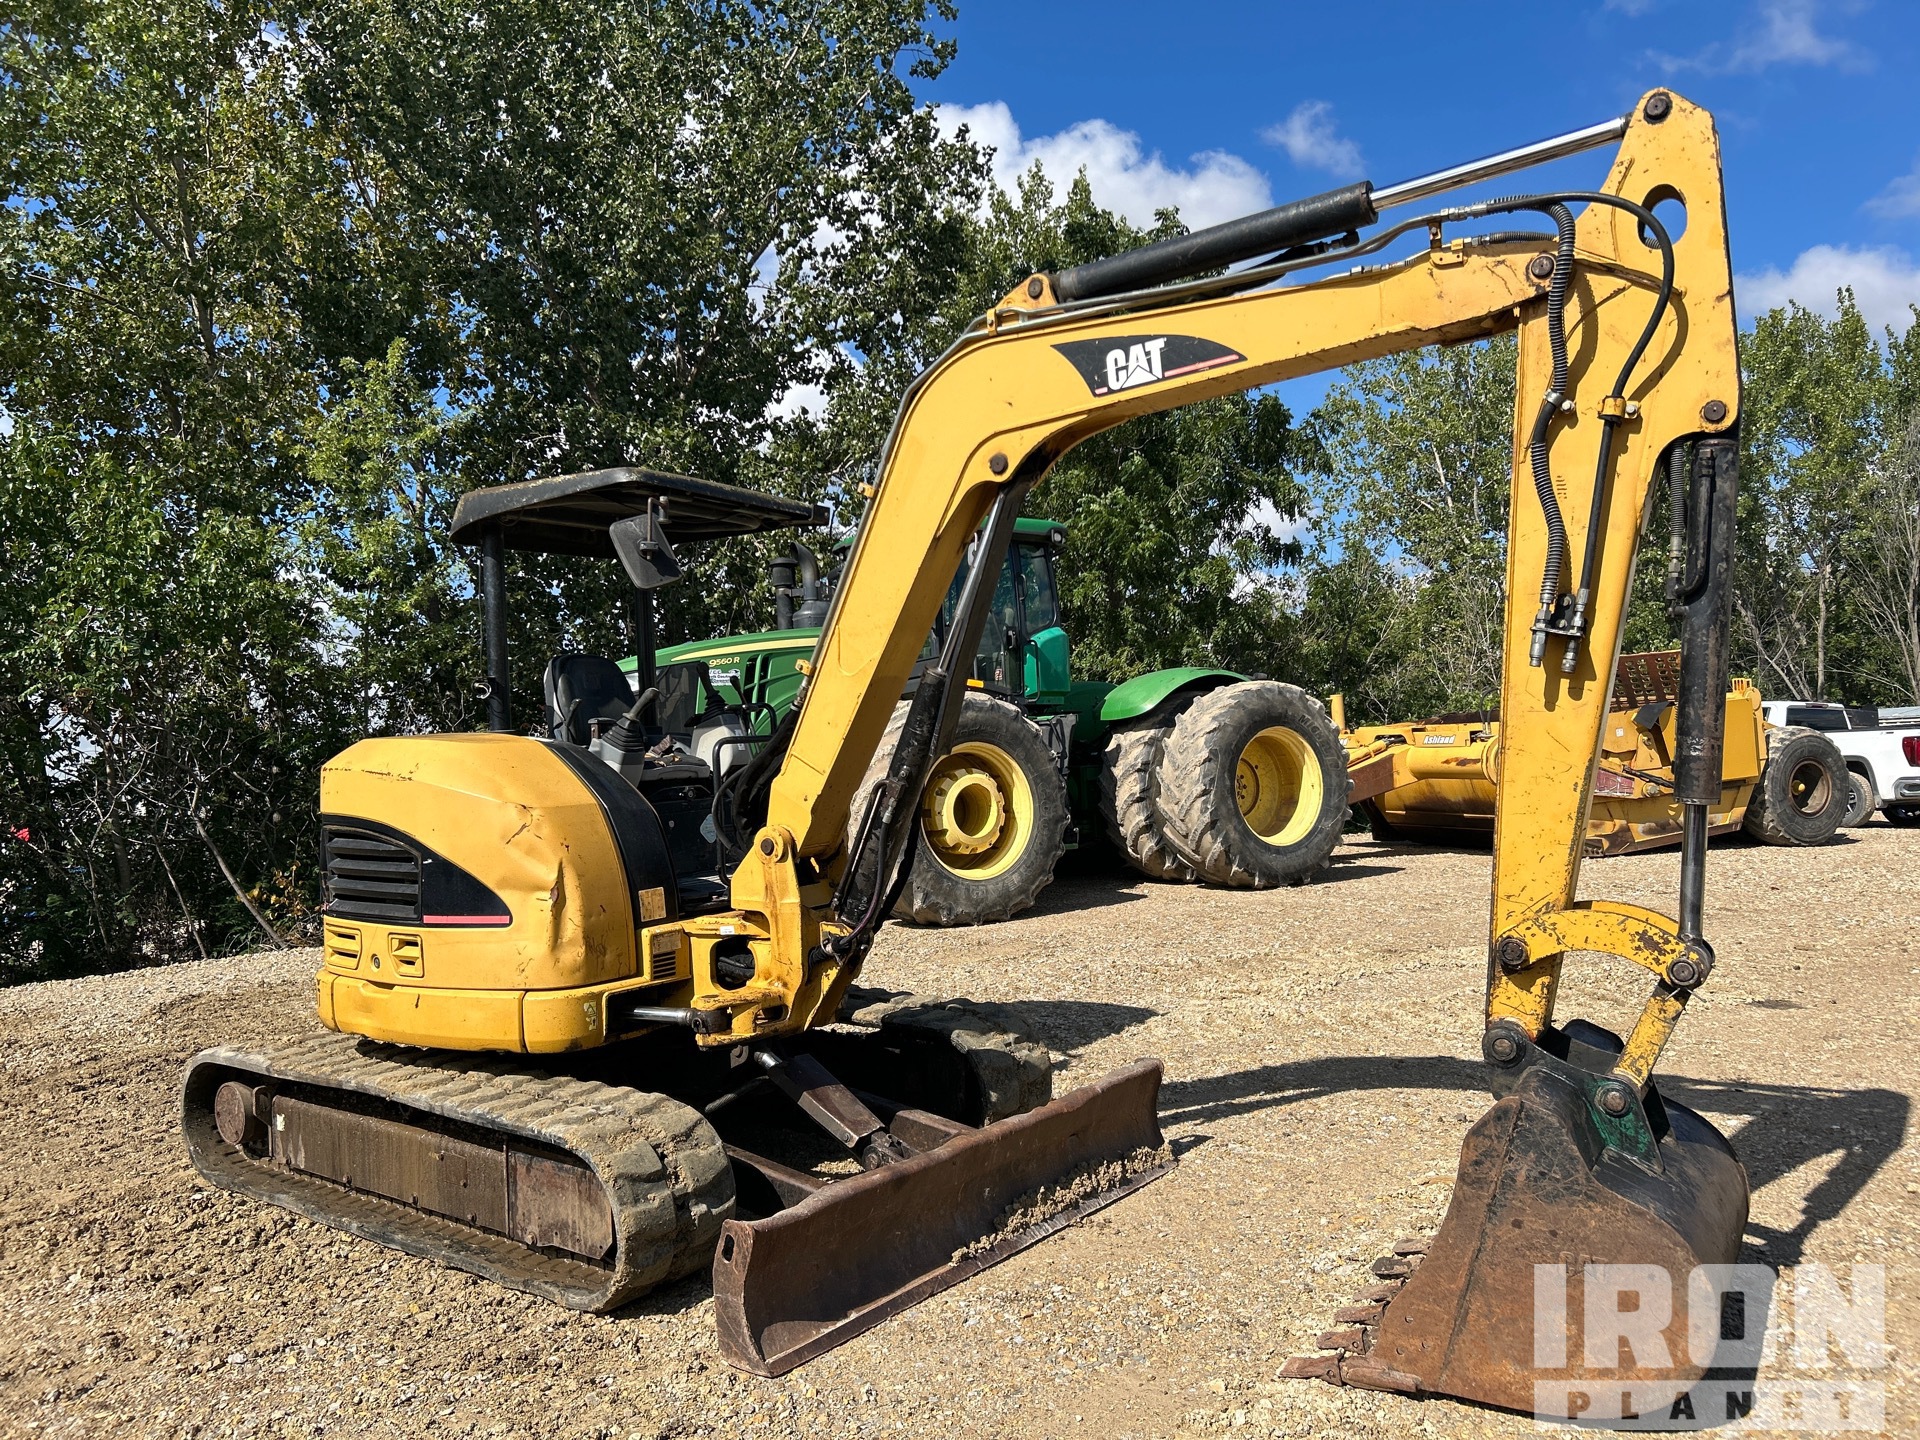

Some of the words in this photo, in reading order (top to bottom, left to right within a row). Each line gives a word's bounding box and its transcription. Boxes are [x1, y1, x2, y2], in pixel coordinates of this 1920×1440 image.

[1106, 337, 1166, 390] CAT
[709, 658, 732, 667] 9560
[1423, 735, 1456, 745] Ashland
